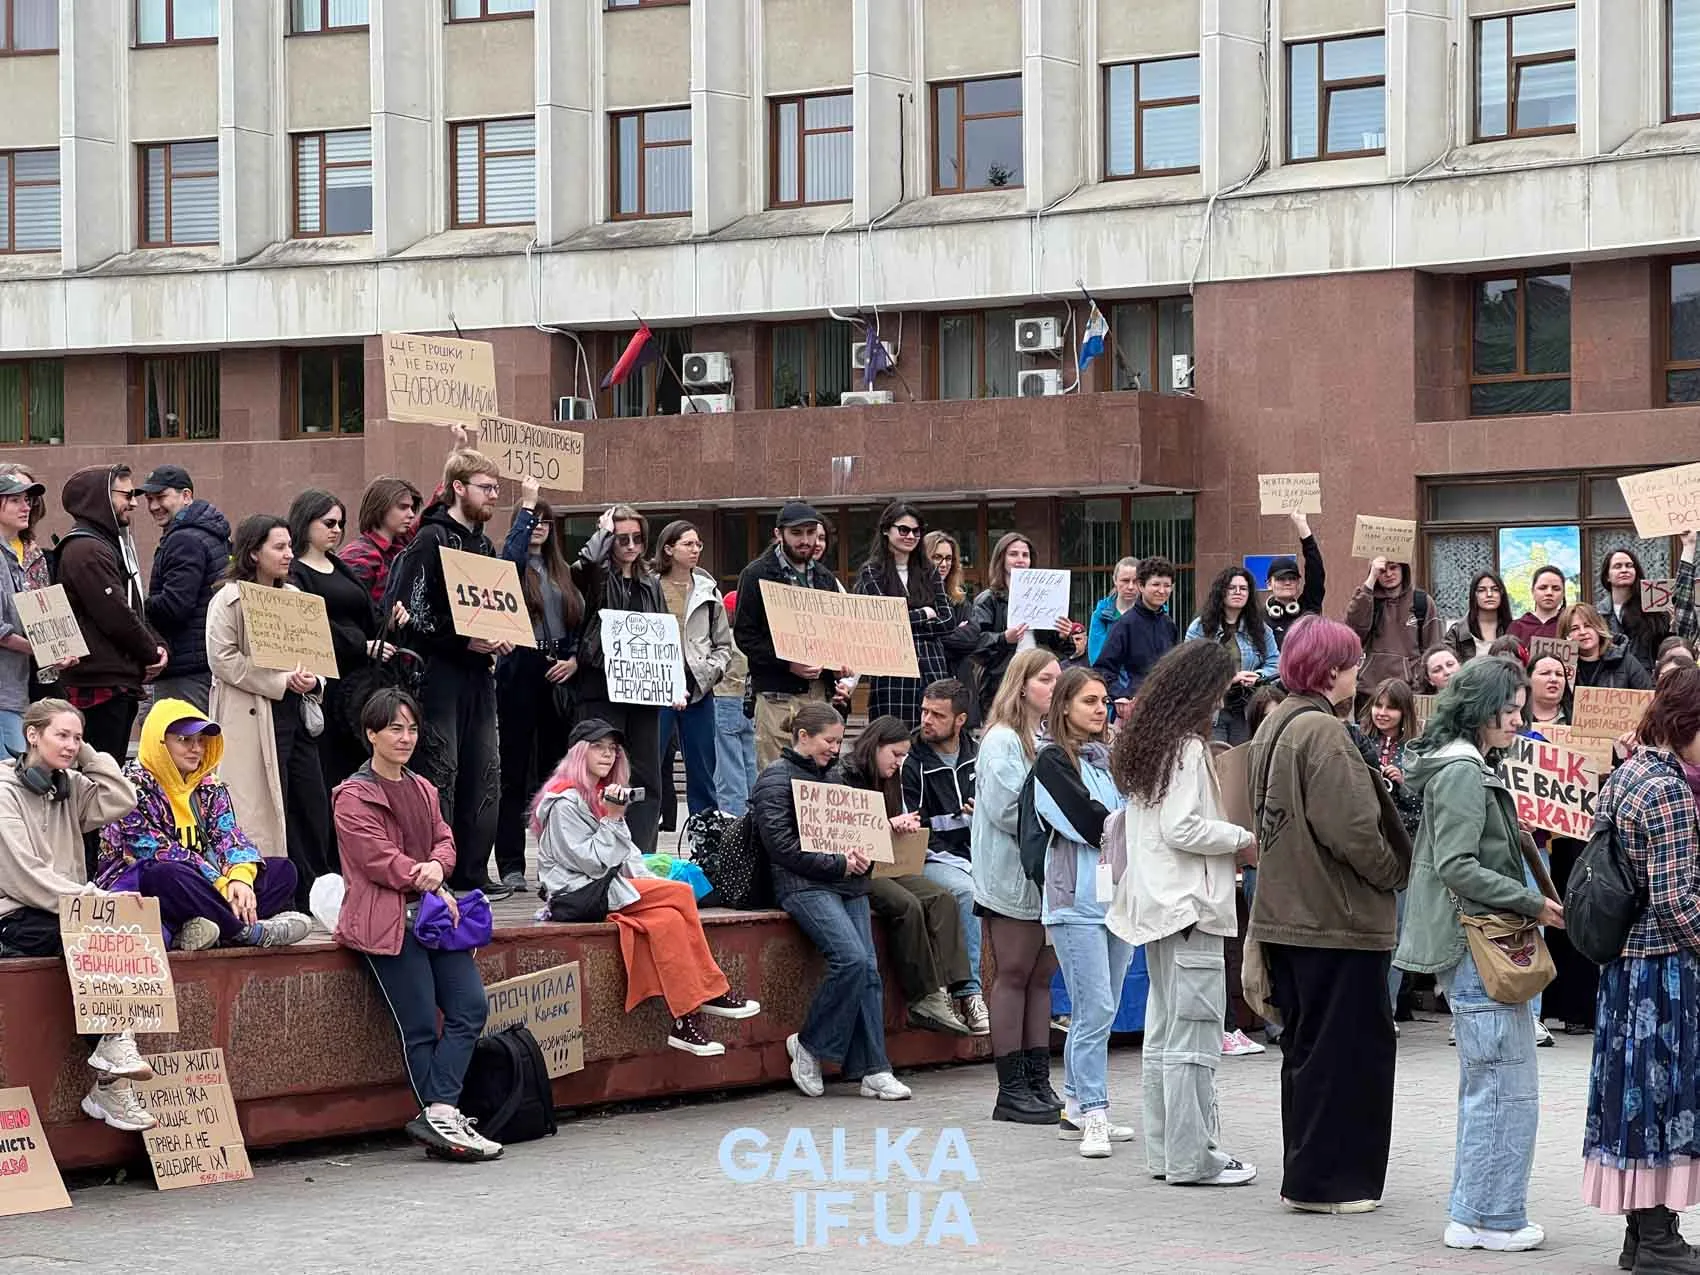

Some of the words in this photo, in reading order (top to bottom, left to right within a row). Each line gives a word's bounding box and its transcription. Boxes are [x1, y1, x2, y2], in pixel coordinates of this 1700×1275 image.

[391, 339, 415, 355] ЩЕ
[421, 343, 463, 359] ТРОШКИ
[405, 358, 421, 370] НЕ
[426, 360, 456, 375] БУДУ
[480, 418, 488, 442] Я
[489, 419, 517, 445] ПРОТИ
[503, 448, 560, 481] 15150
[456, 583, 518, 613] 15150
[612, 639, 622, 657] Я
[654, 643, 680, 661] ПРОТИ
[608, 657, 673, 682] ЛЕГАЛІЗАЦІЇ
[1539, 745, 1589, 788] ЦК
[800, 784, 820, 802] ВИ
[826, 787, 869, 810] КОЖЕН
[800, 803, 821, 825] РІК
[69, 898, 81, 922] А
[92, 898, 116, 925] ЦЯ
[88, 934, 141, 953] ДОБРО-
[72, 953, 159, 976] ЗВИЧАЙНІСТЬ
[92, 982, 124, 996] НАМИ
[131, 982, 163, 996] ЗАРАЗ
[92, 1000, 122, 1017] ОДНІЙ
[128, 1003, 164, 1018] КІМНАТІ
[148, 1055, 180, 1076] ХОЧУ
[184, 1051, 220, 1072] ЖИТИ
[186, 1086, 209, 1104] ЯКА
[0, 1136, 36, 1153] НІСТЬ
[185, 1133, 193, 1150] А
[195, 1131, 211, 1149] НЕ
[155, 1155, 206, 1178] ВІДБИРАЄ
